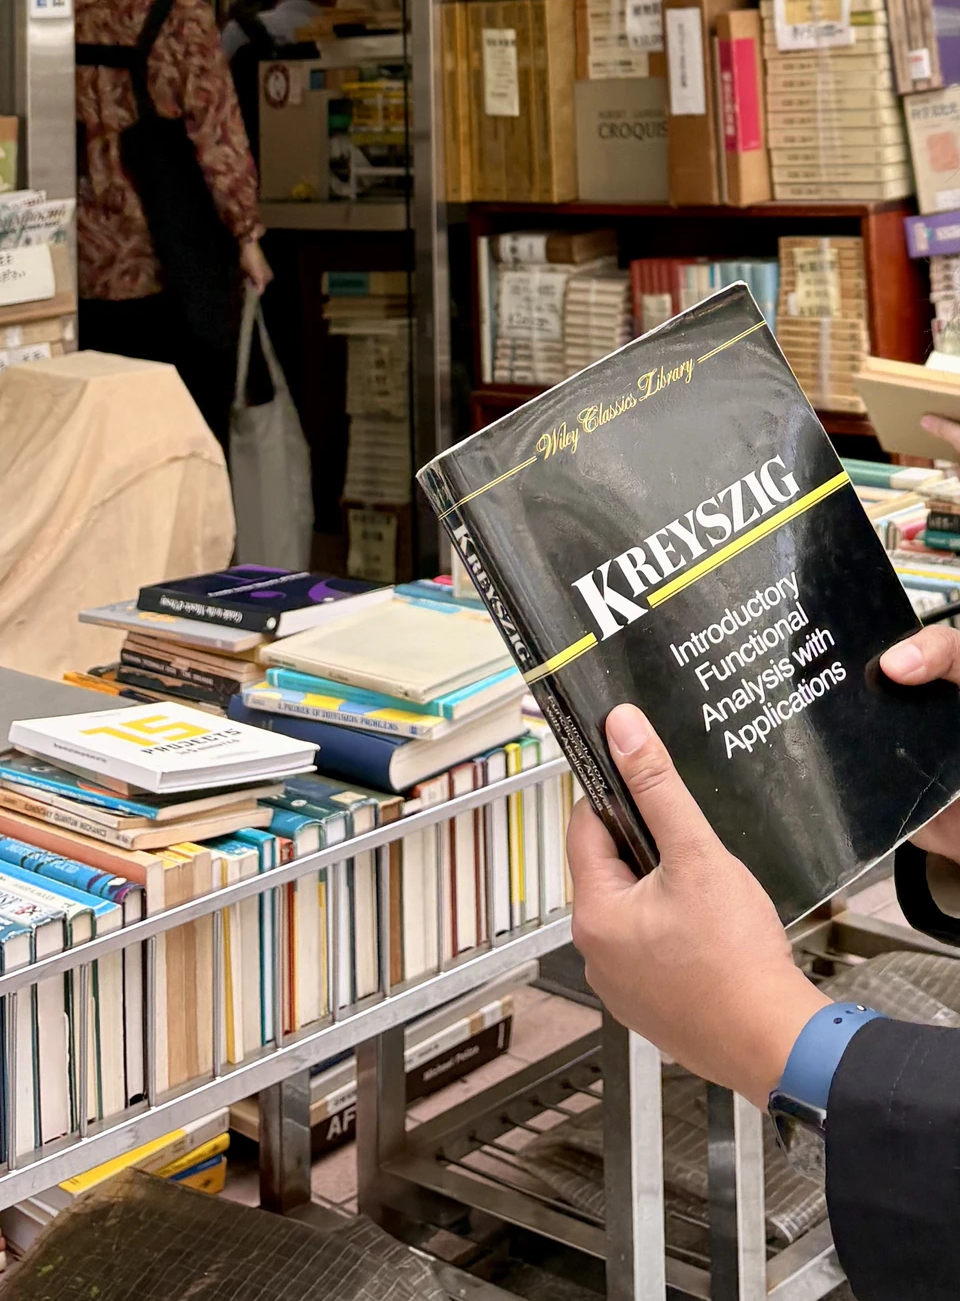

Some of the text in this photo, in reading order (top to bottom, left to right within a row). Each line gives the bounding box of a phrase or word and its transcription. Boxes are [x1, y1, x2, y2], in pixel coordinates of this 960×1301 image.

[535, 358, 695, 461] Wiley Classics Library
[453, 524, 534, 665] KREYSZIG
[571, 454, 800, 641] KREYSZIG
[669, 571, 800, 667] Introductory
[694, 601, 810, 691] Functional
[702, 627, 836, 732] Analysis with
[723, 660, 847, 759] Applications
[78, 714, 213, 747] 15
[140, 728, 243, 755] PROJECTS
[546, 707, 604, 811] with Applications
[548, 695, 614, 817] Functional Analysis
[566, 715, 608, 790] Introductory
